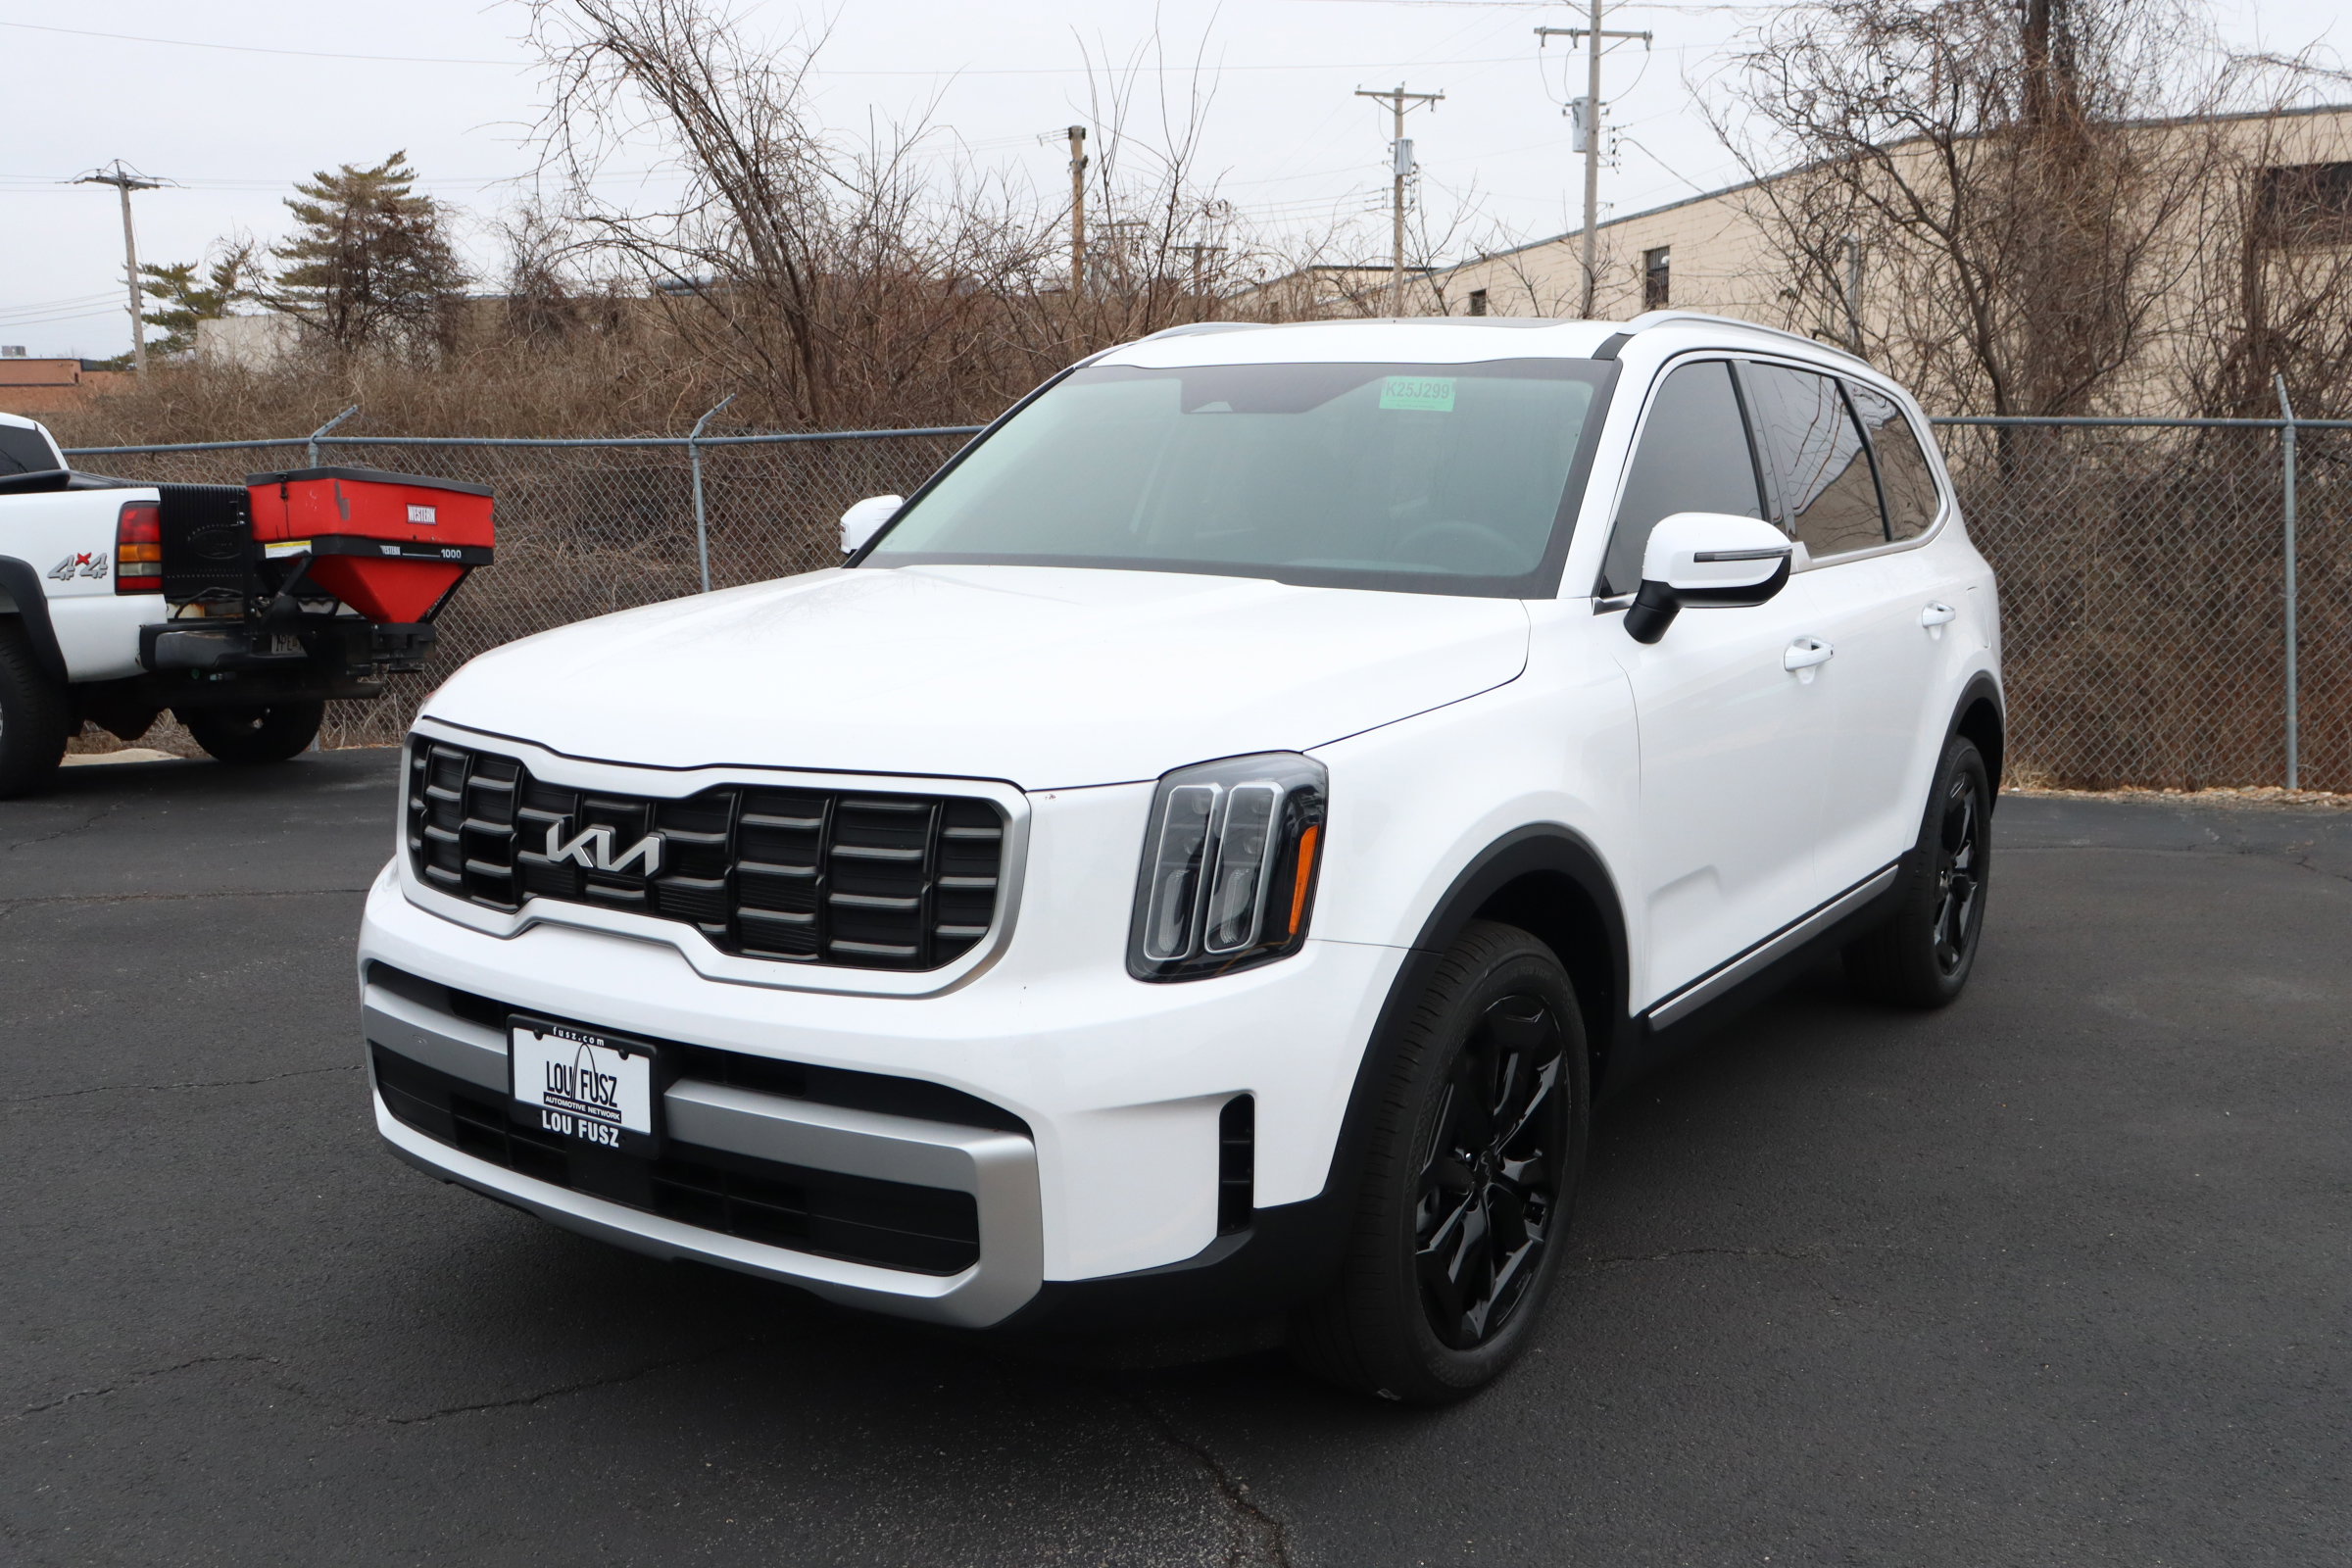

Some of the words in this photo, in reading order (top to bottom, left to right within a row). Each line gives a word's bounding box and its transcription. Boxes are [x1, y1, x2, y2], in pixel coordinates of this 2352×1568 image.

[1386, 381, 1450, 400] K25J299
[407, 506, 436, 523] WESTERN
[441, 549, 462, 559] 1000
[553, 1026, 605, 1047] fusz.com
[546, 1060, 572, 1096] LOU
[580, 1069, 617, 1108] FUSZ
[545, 1096, 586, 1112] AUTOMOTIVE
[588, 1106, 620, 1121] NETWORK
[542, 1109, 572, 1135] LOU
[578, 1119, 619, 1148] FUSZ
